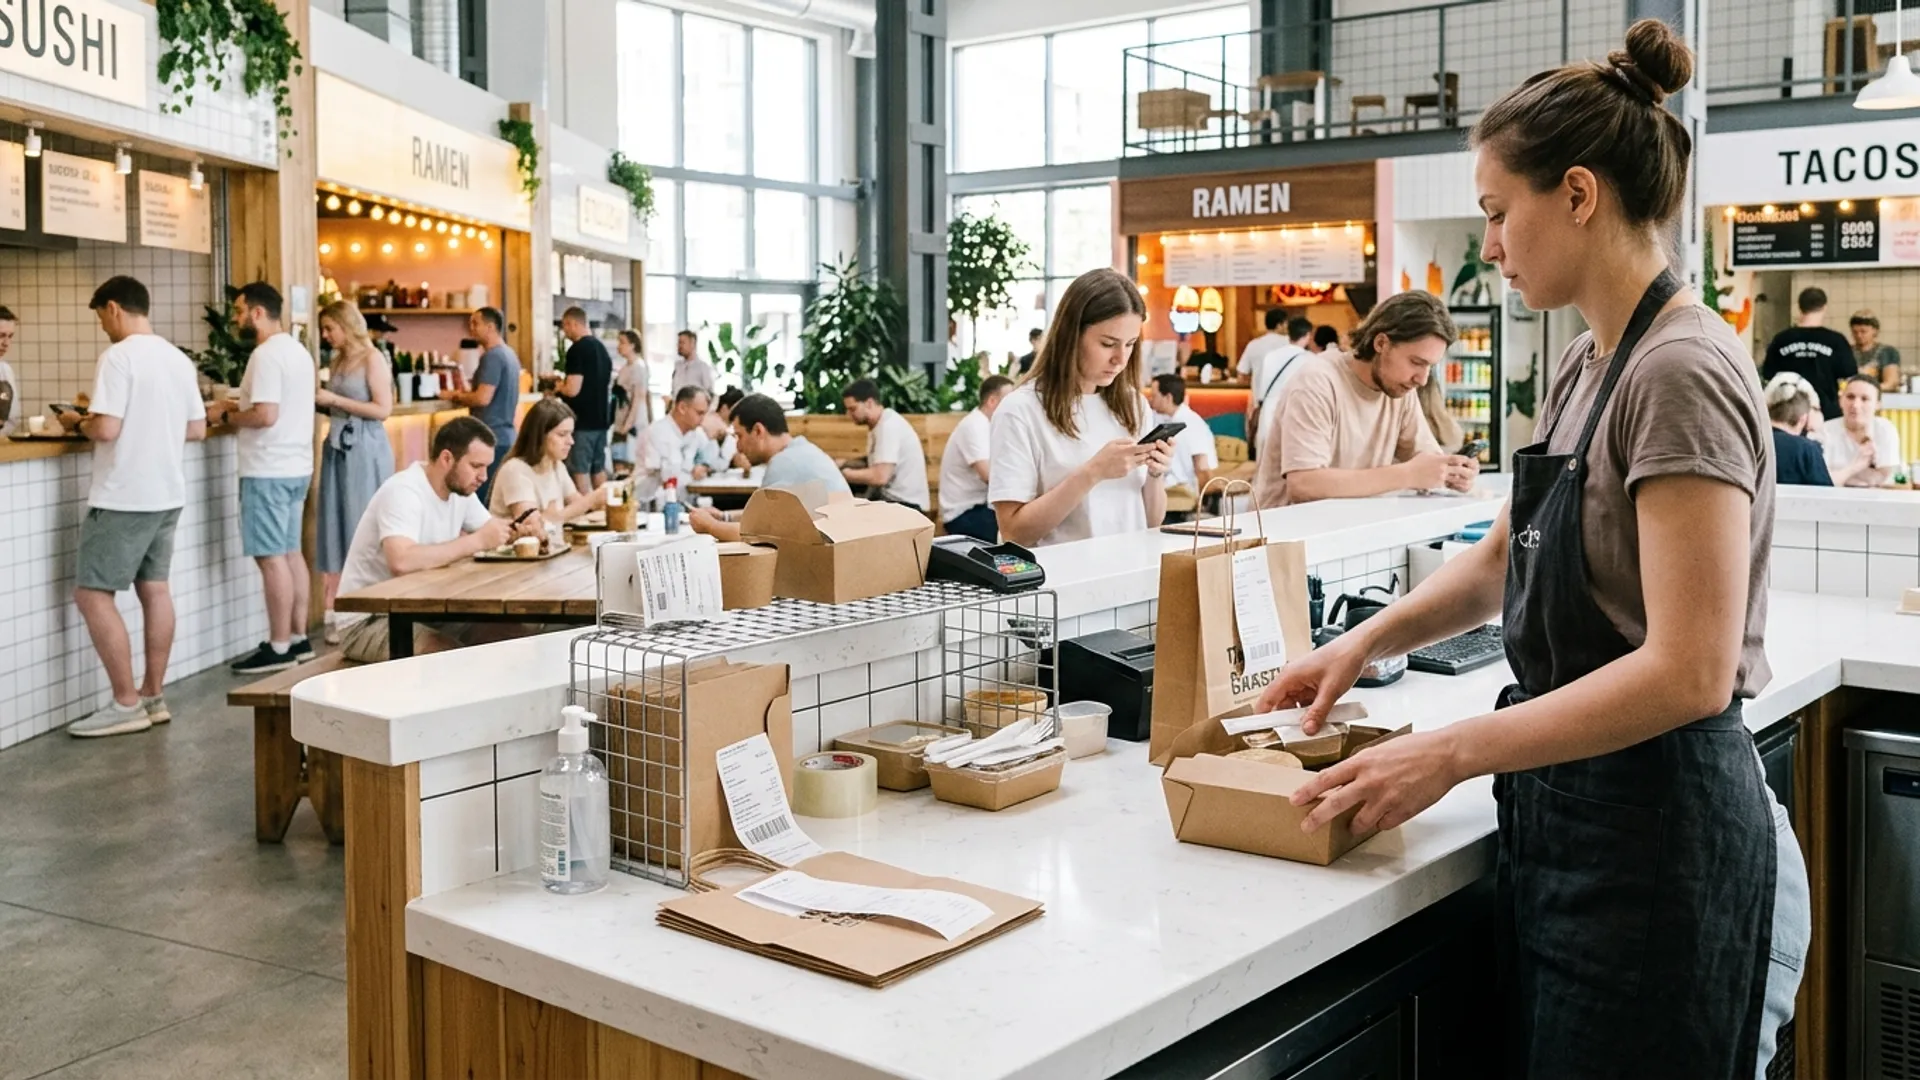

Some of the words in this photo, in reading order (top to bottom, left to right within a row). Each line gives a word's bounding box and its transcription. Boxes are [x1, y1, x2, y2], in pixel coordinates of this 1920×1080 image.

[412, 135, 470, 190] RAMEN
[1778, 142, 1919, 186] TACOS
[1193, 182, 1290, 218] RAMEN
